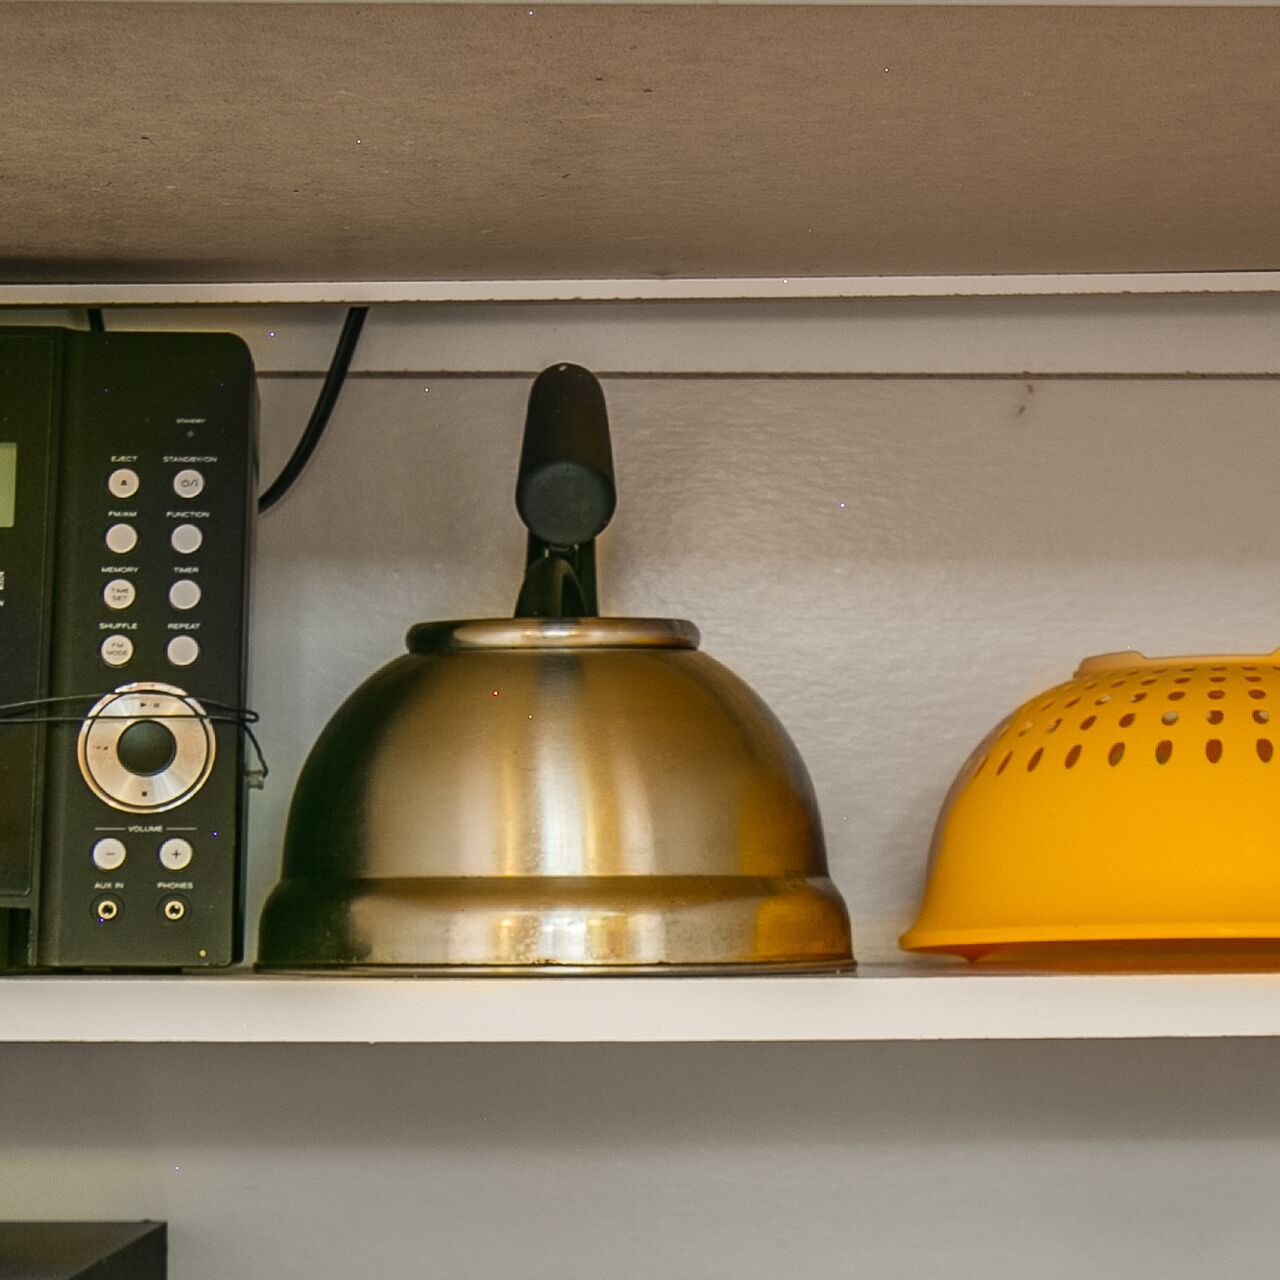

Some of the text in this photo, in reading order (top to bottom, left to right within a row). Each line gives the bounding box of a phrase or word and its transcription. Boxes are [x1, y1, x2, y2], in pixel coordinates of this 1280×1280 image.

[111, 455, 138, 463] EJECT
[163, 455, 218, 463] STANDBY/ON
[166, 511, 210, 519] FUNCTION
[101, 566, 139, 574] MEMORY
[173, 566, 199, 574] TIMER
[99, 622, 138, 630] SHUFFLE
[127, 825, 164, 833] VOLUME
[94, 882, 125, 890] AUX IN
[157, 882, 194, 890] PHONES
